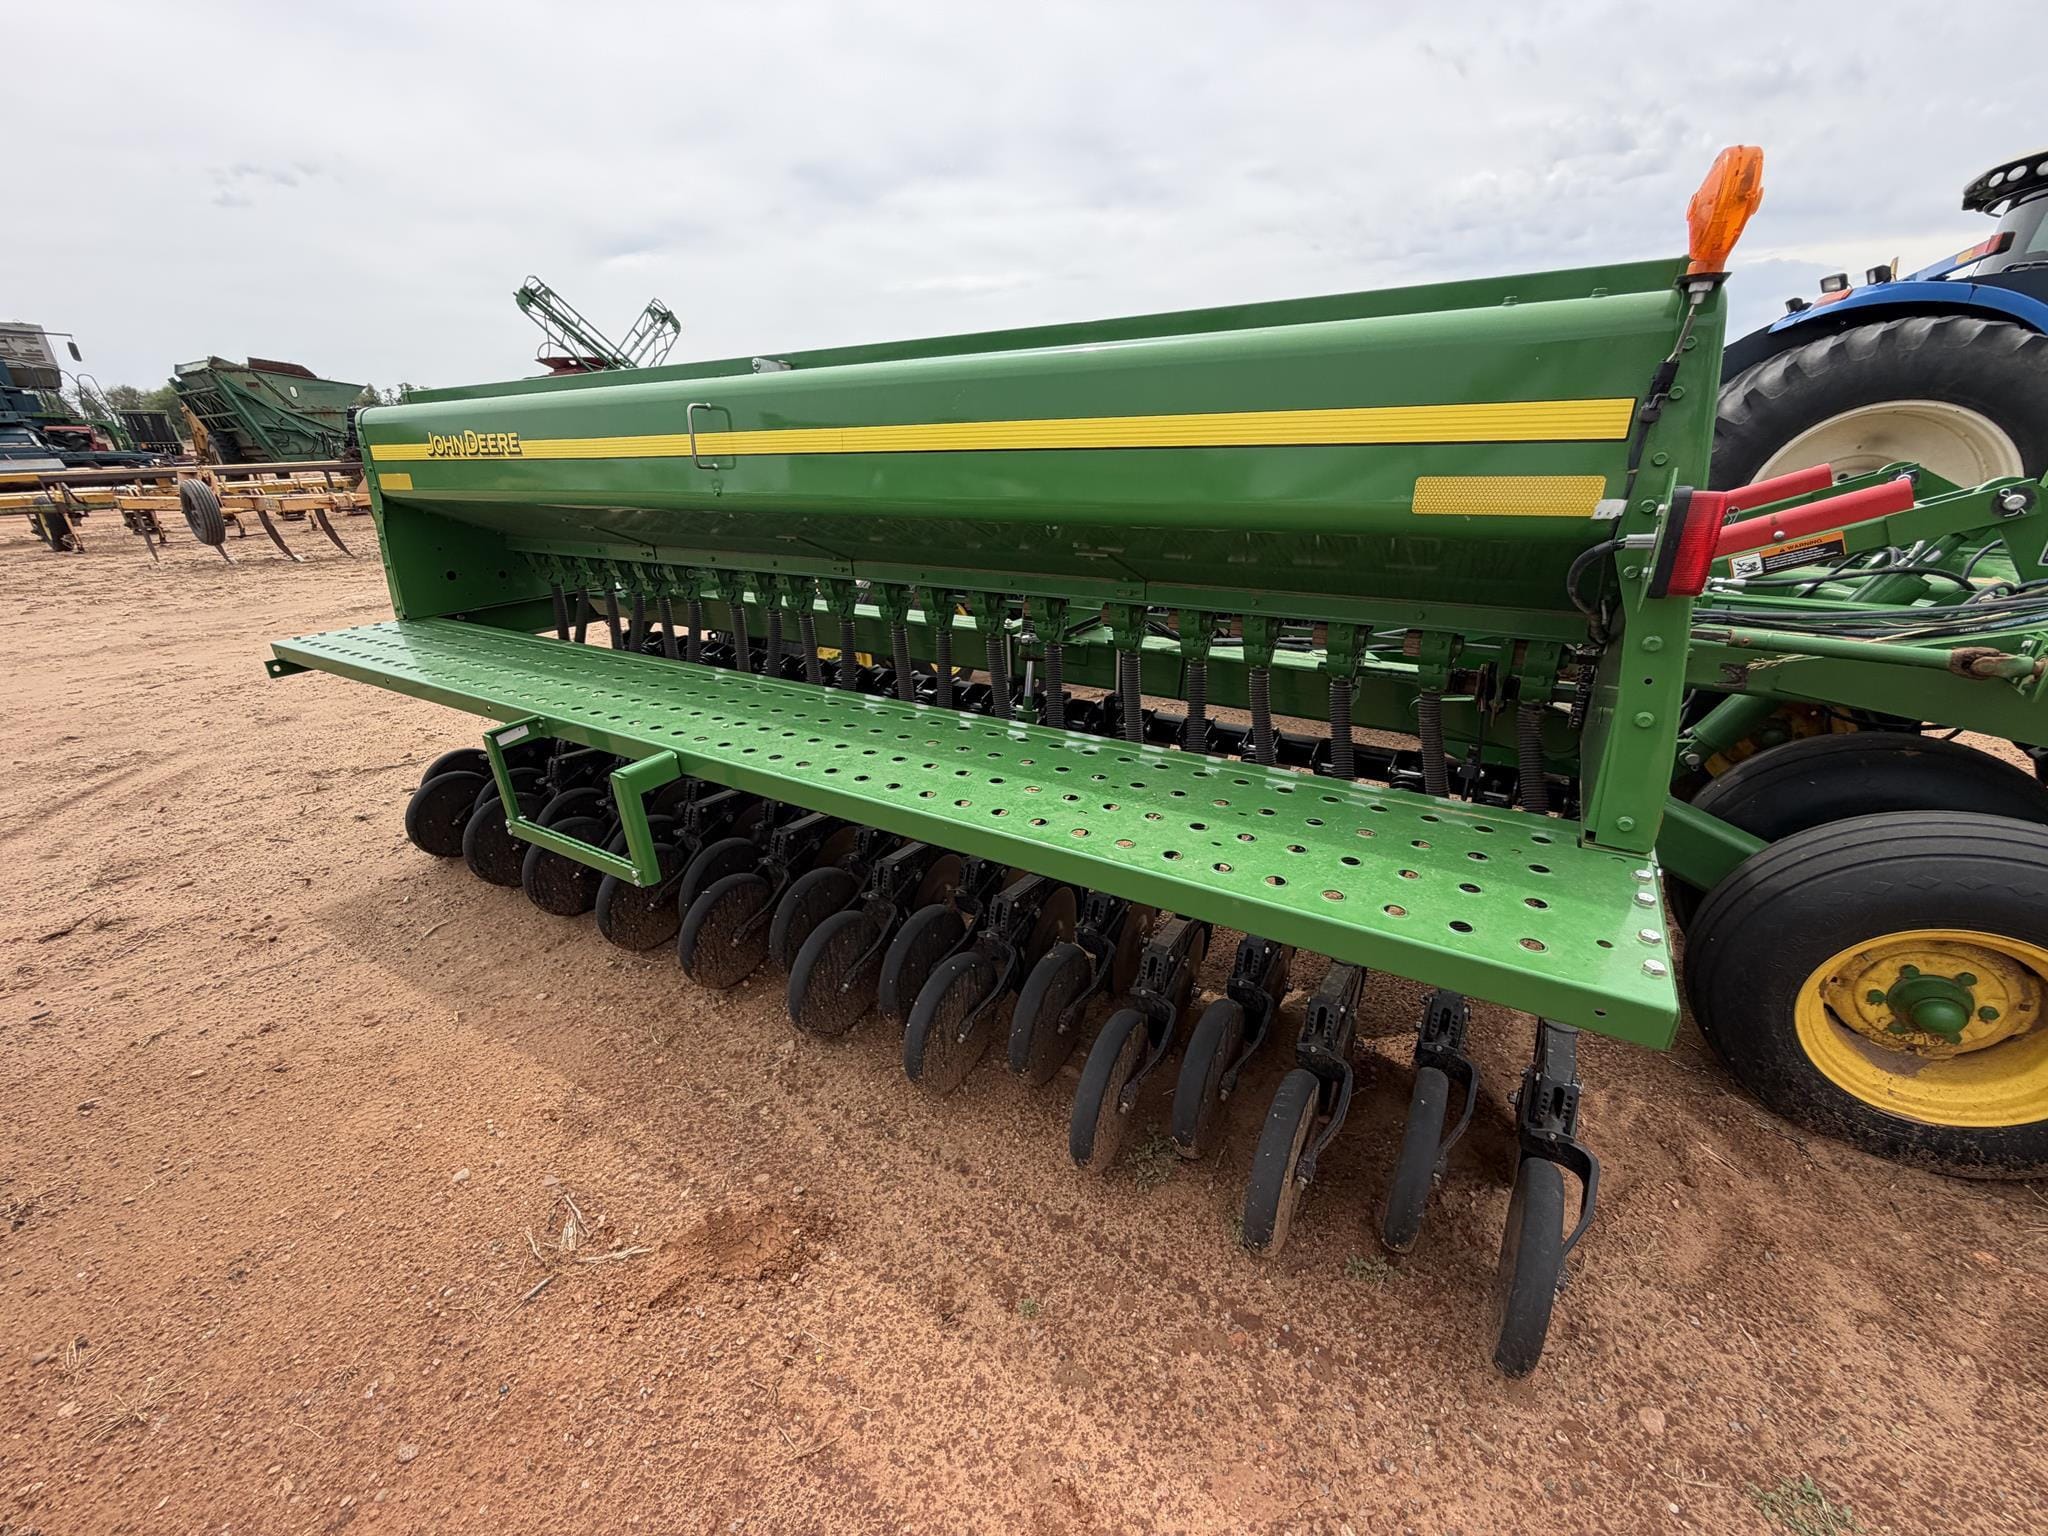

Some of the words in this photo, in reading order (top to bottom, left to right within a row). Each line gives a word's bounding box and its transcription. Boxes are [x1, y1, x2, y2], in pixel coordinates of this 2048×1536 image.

[427, 432, 465, 456] JOHN
[464, 430, 522, 455] DEERE
[1787, 538, 1823, 550] WARNING
